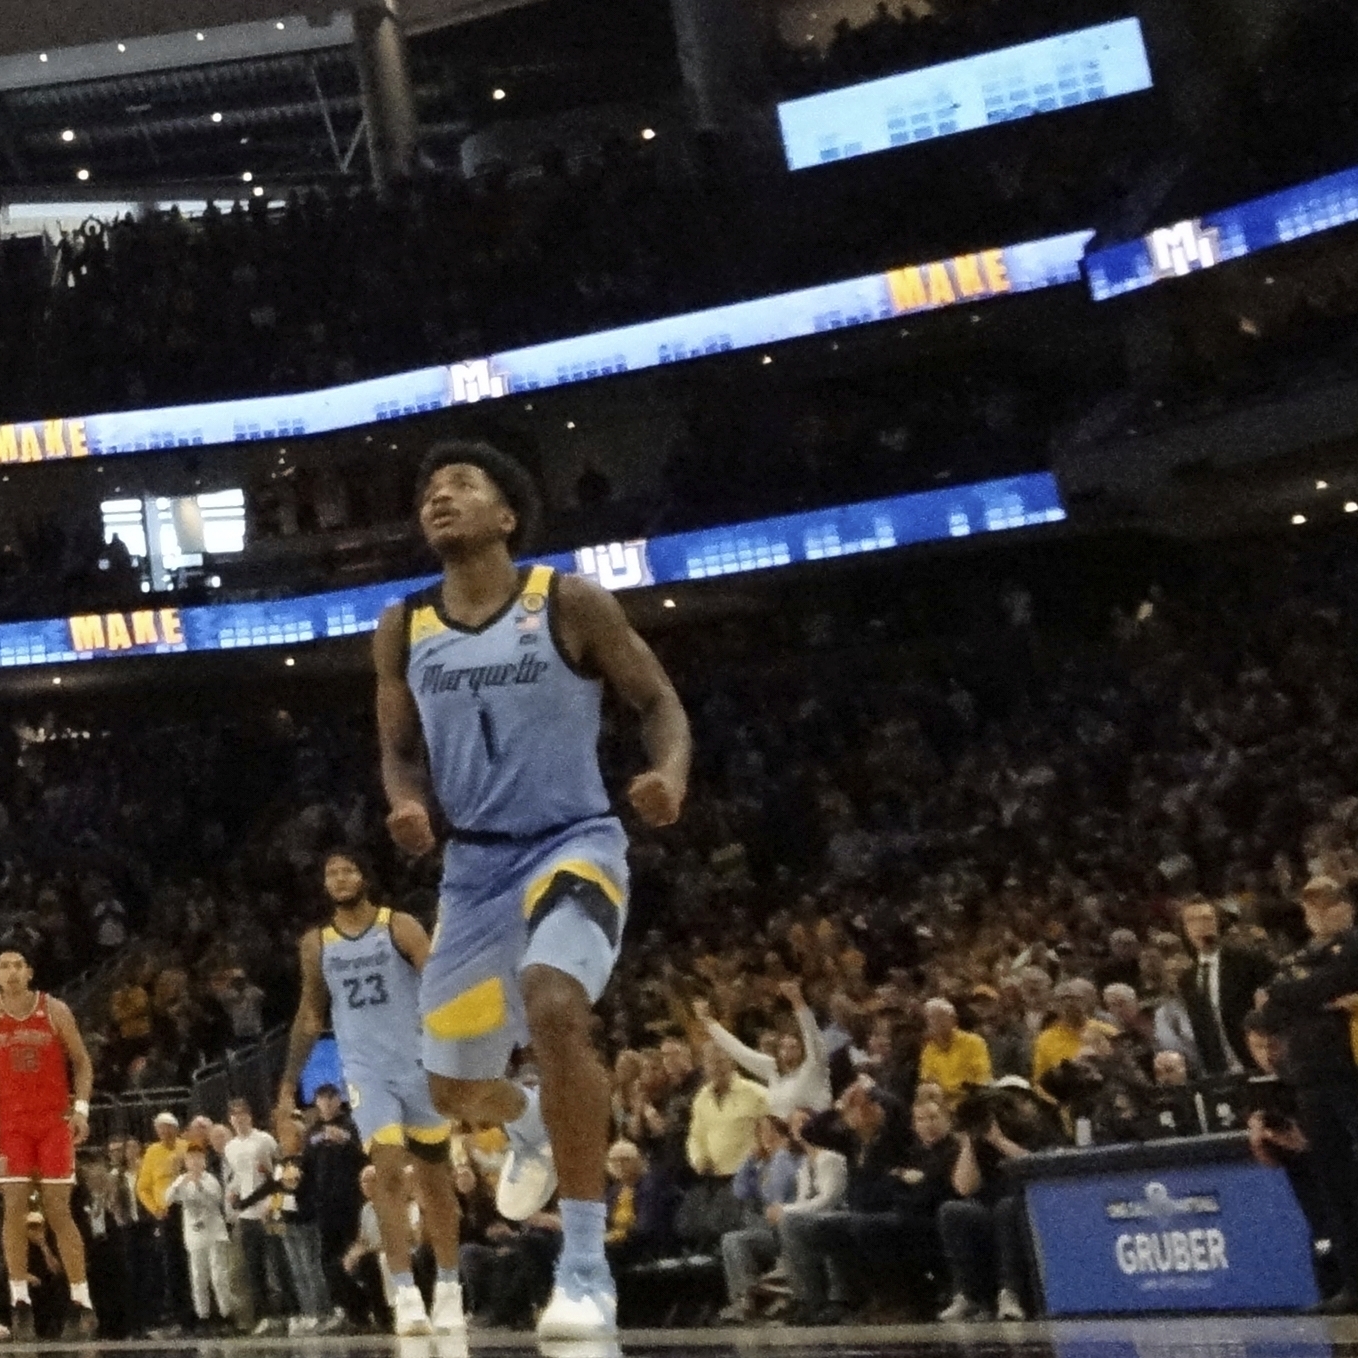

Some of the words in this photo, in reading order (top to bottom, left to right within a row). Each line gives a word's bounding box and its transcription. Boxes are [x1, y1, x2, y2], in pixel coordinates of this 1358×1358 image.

[887, 248, 1011, 312] MAKE
[67, 608, 184, 654] MAKE
[342, 973, 389, 1010] 23
[1115, 1227, 1229, 1276] GRUBER
